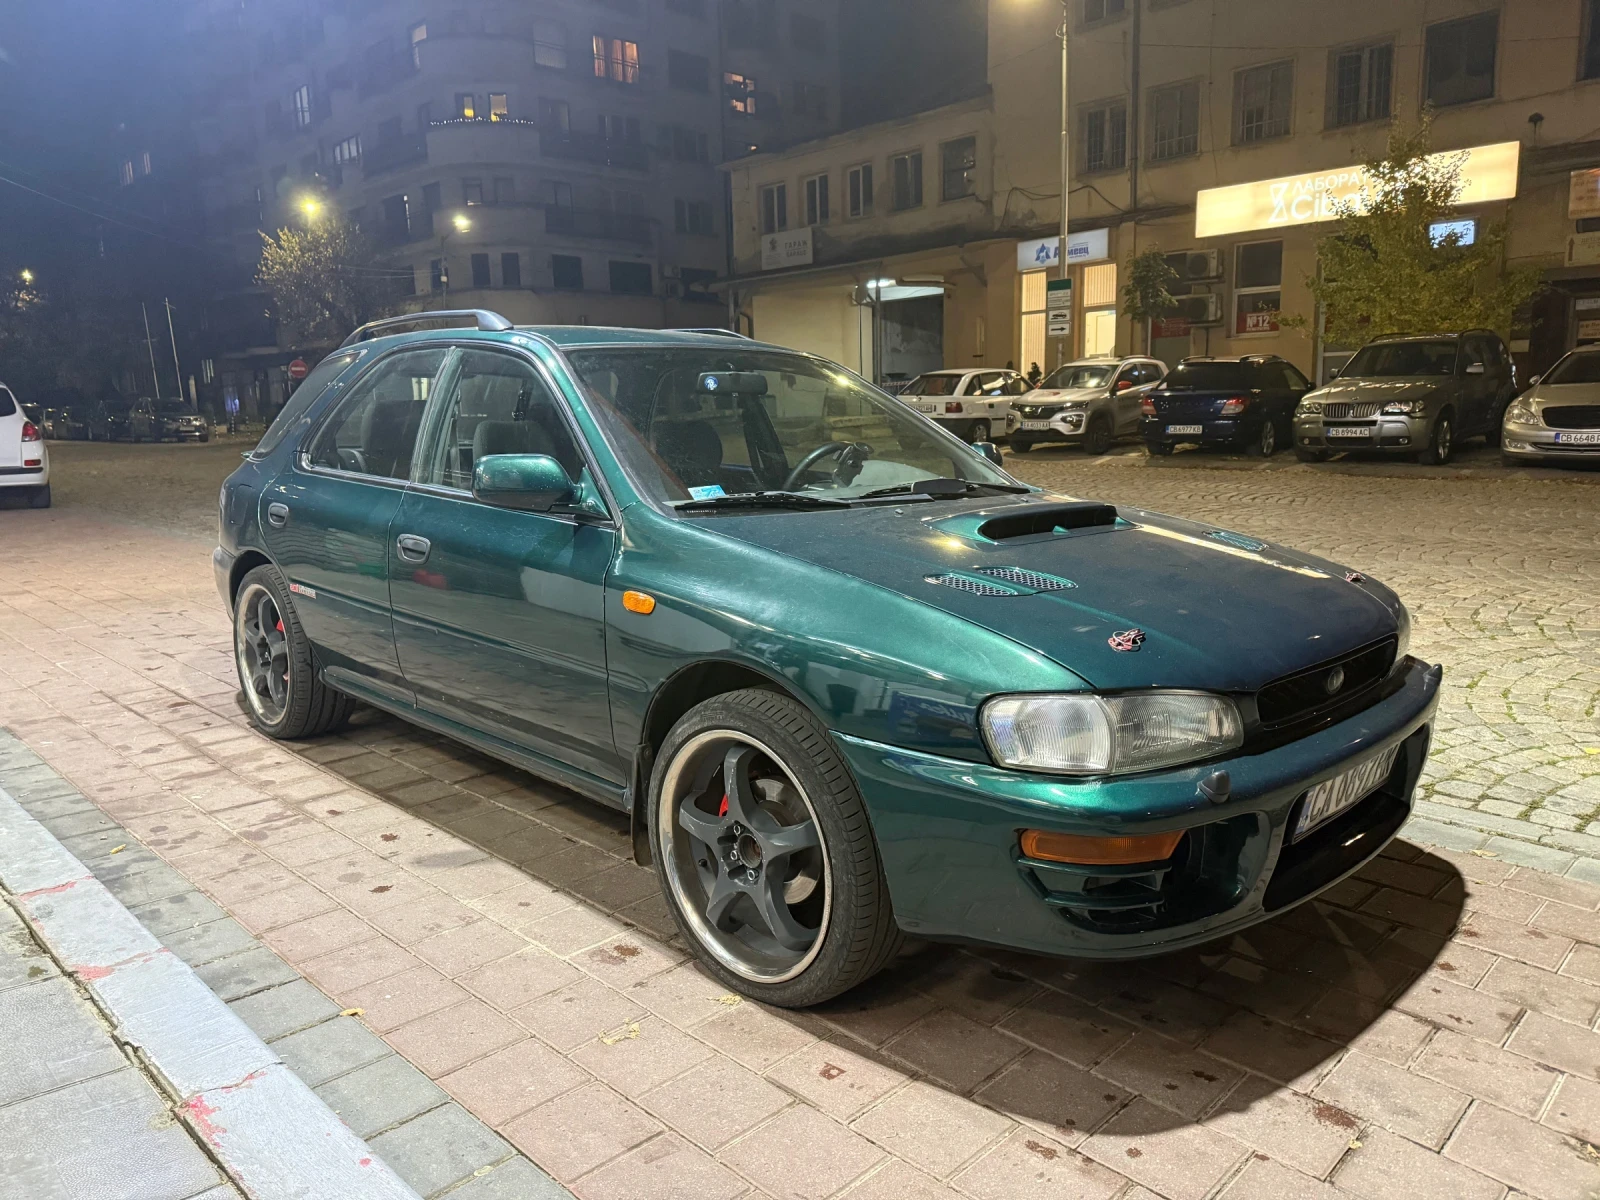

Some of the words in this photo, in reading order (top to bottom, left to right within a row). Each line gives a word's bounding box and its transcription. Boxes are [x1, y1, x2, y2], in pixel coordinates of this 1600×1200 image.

[1053, 246, 1090, 259] Амеец
[1560, 434, 1572, 442] CB
[1573, 434, 1596, 443] 6648
[1309, 778, 1336, 822] CA
